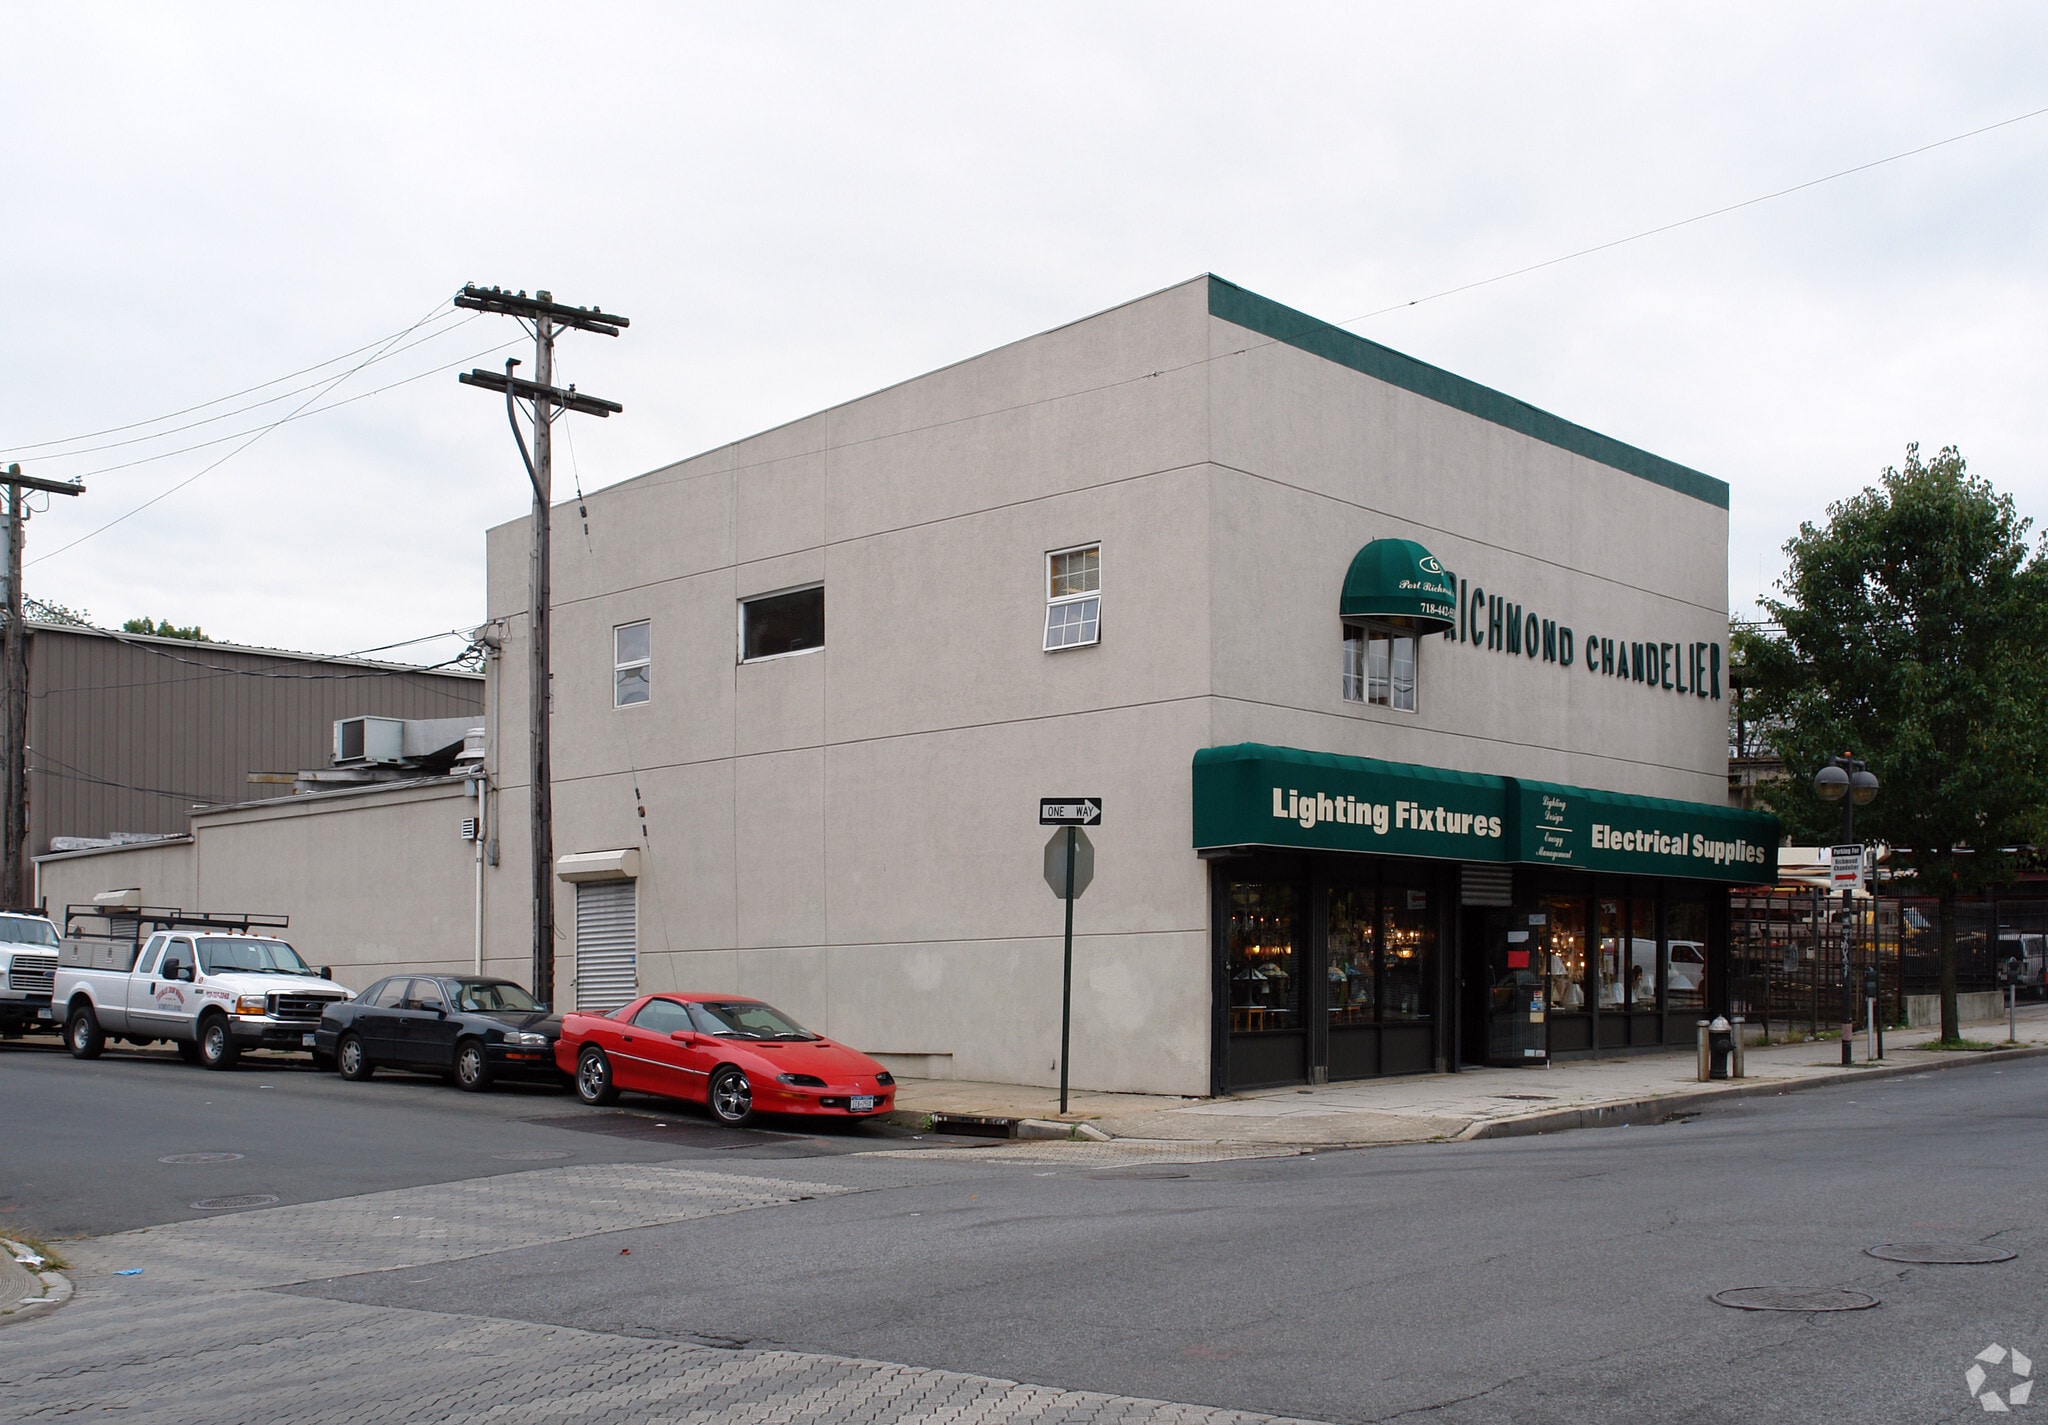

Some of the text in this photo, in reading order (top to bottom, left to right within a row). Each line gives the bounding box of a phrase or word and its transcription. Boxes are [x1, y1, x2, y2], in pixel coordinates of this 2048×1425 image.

[1399, 579, 1421, 590] Port
[1586, 634, 1721, 700] CHANDELIER
[1048, 806, 1094, 817] ONE WAY
[1542, 795, 1567, 812] Lighting
[1272, 787, 1502, 838] Lighting Fixtures
[1544, 809, 1564, 825] Design
[1591, 823, 1766, 866] Electrical Supplies
[1536, 846, 1573, 861] Management
